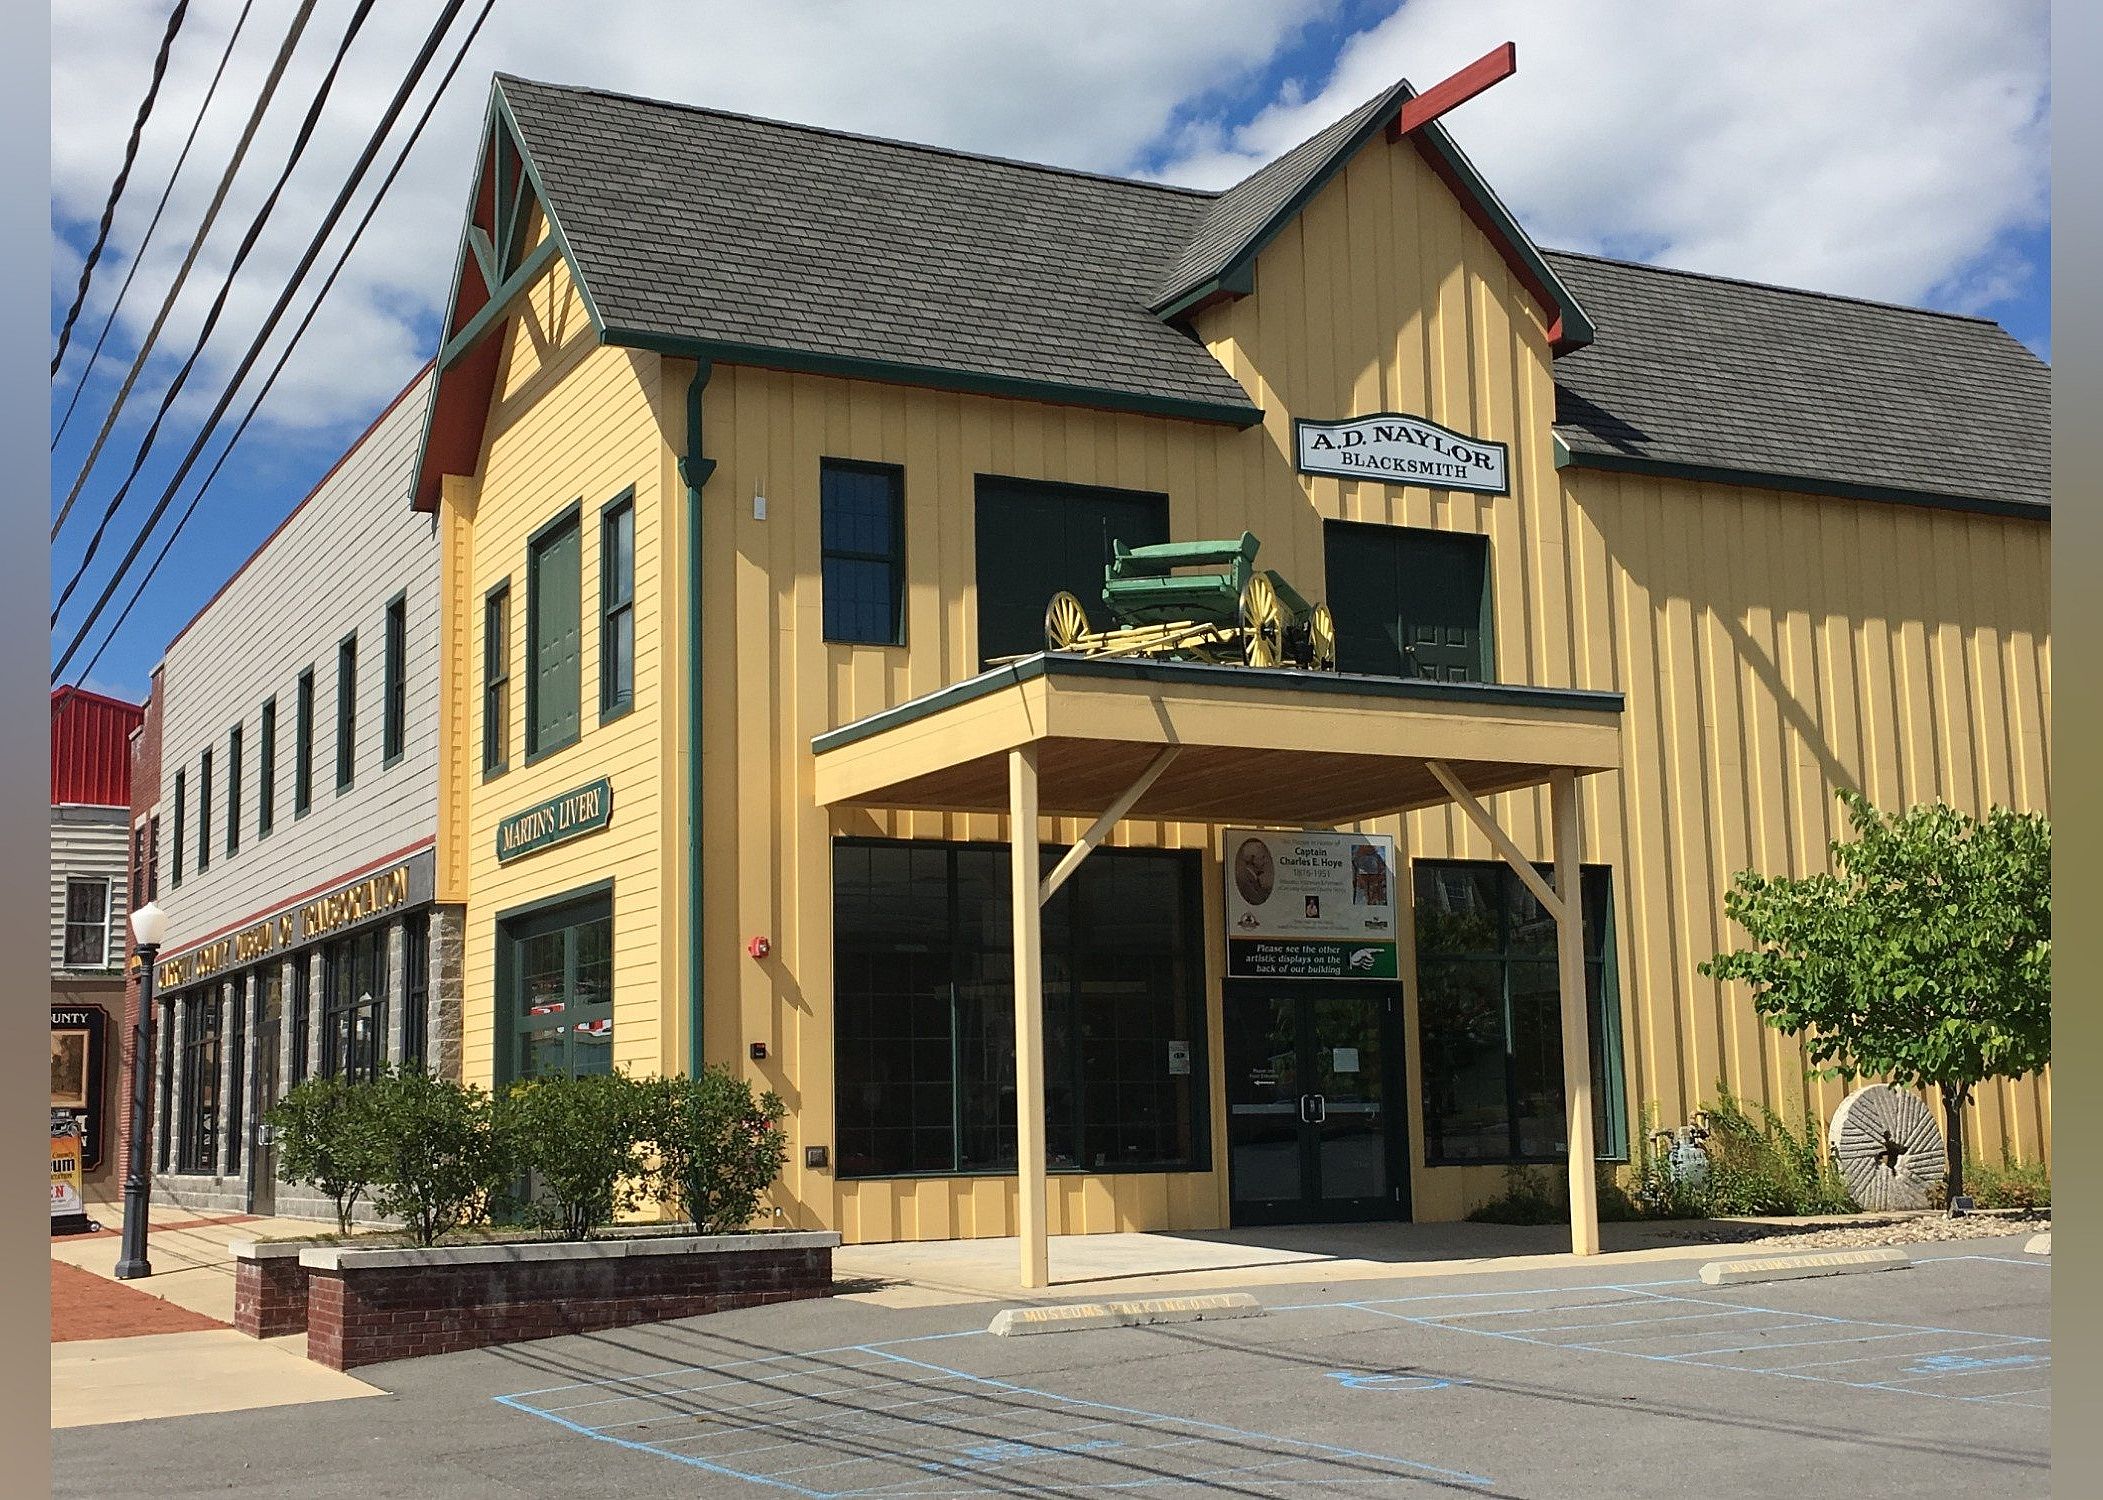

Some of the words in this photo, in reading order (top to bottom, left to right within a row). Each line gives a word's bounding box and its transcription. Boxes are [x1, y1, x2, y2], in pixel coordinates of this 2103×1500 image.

[1311, 430, 1366, 450] A.D.
[1373, 426, 1494, 471] NAYLOR
[1341, 451, 1467, 478] BLACKSMITH
[503, 806, 555, 851] MARTIN'S
[559, 787, 602, 830] LIVERY
[1295, 846, 1327, 857] Captain
[1280, 856, 1310, 866] Charles
[1321, 858, 1342, 869] Hoye
[1257, 944, 1282, 953] Please
[1302, 945, 1316, 953] the
[1319, 945, 1340, 954] other
[1246, 954, 1276, 963] artistic
[1278, 955, 1311, 965] displays
[1327, 955, 1340, 964] the
[1256, 964, 1276, 973] back
[1278, 964, 1288, 973] of
[1290, 965, 1305, 973] our
[1308, 965, 1340, 975] building
[51, 1013, 88, 1024] UNTY
